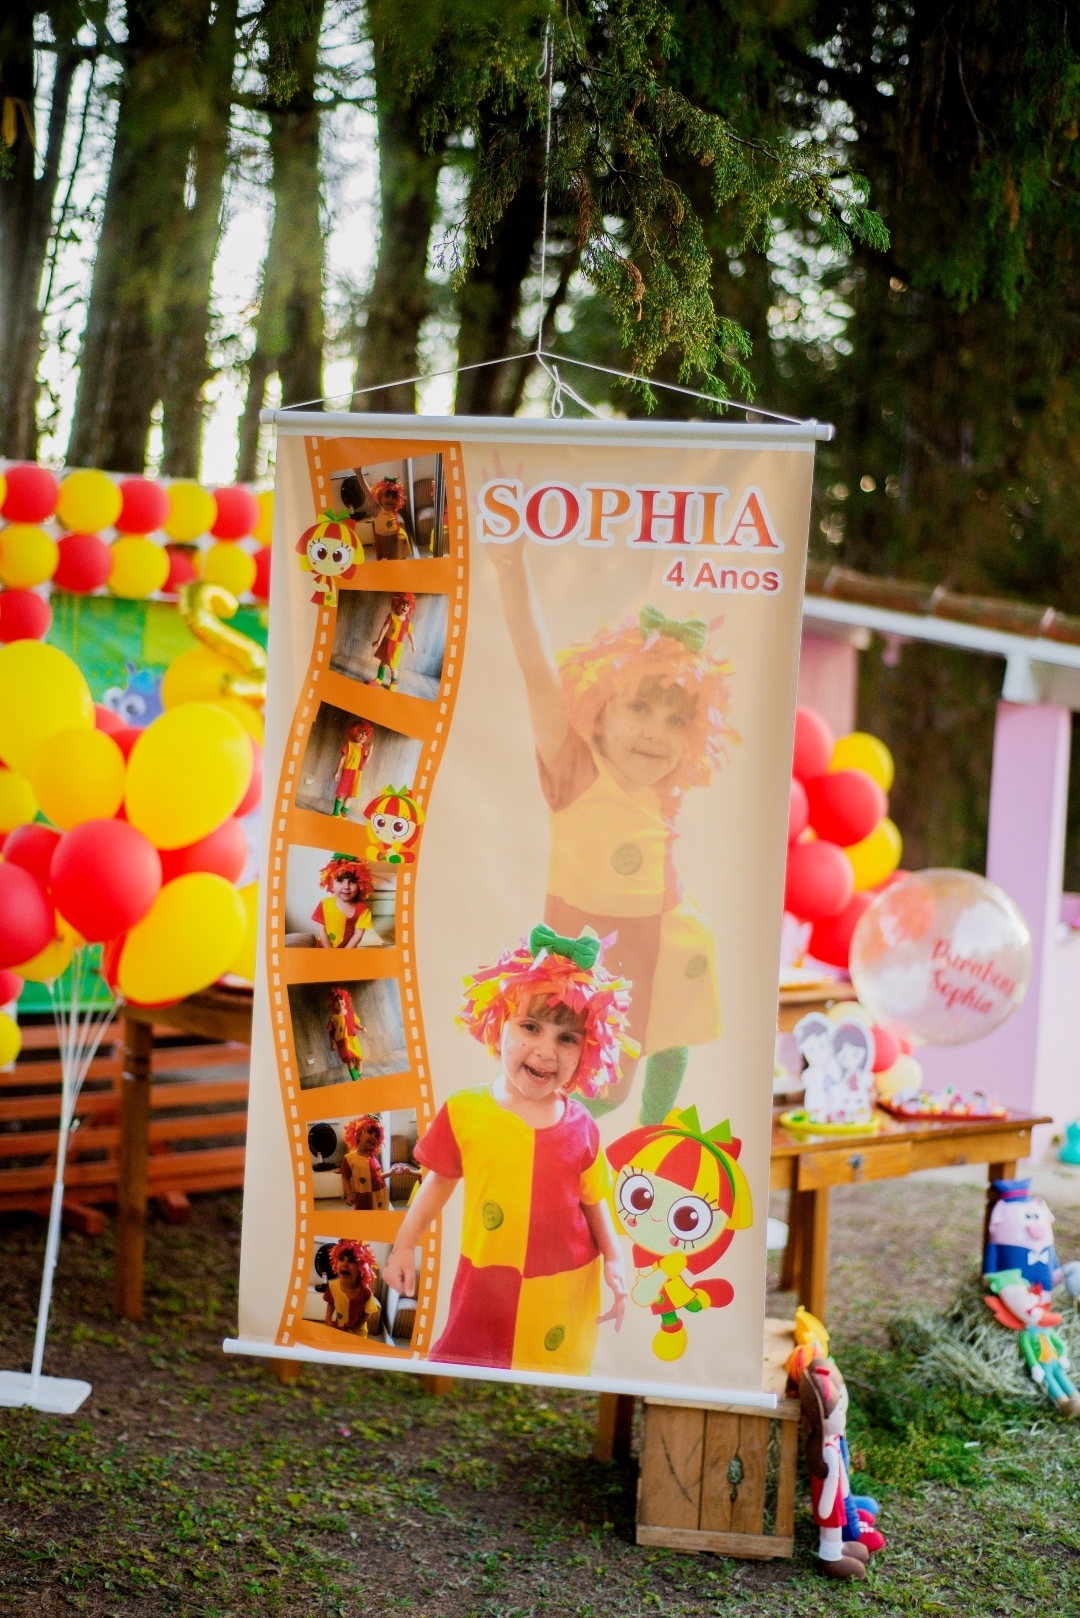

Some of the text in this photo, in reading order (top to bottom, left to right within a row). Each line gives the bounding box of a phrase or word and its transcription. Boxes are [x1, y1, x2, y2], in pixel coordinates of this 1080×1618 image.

[481, 484, 780, 549] SOPHIA
[666, 561, 780, 592] 4 Anos
[933, 969, 993, 1014] Sophia
